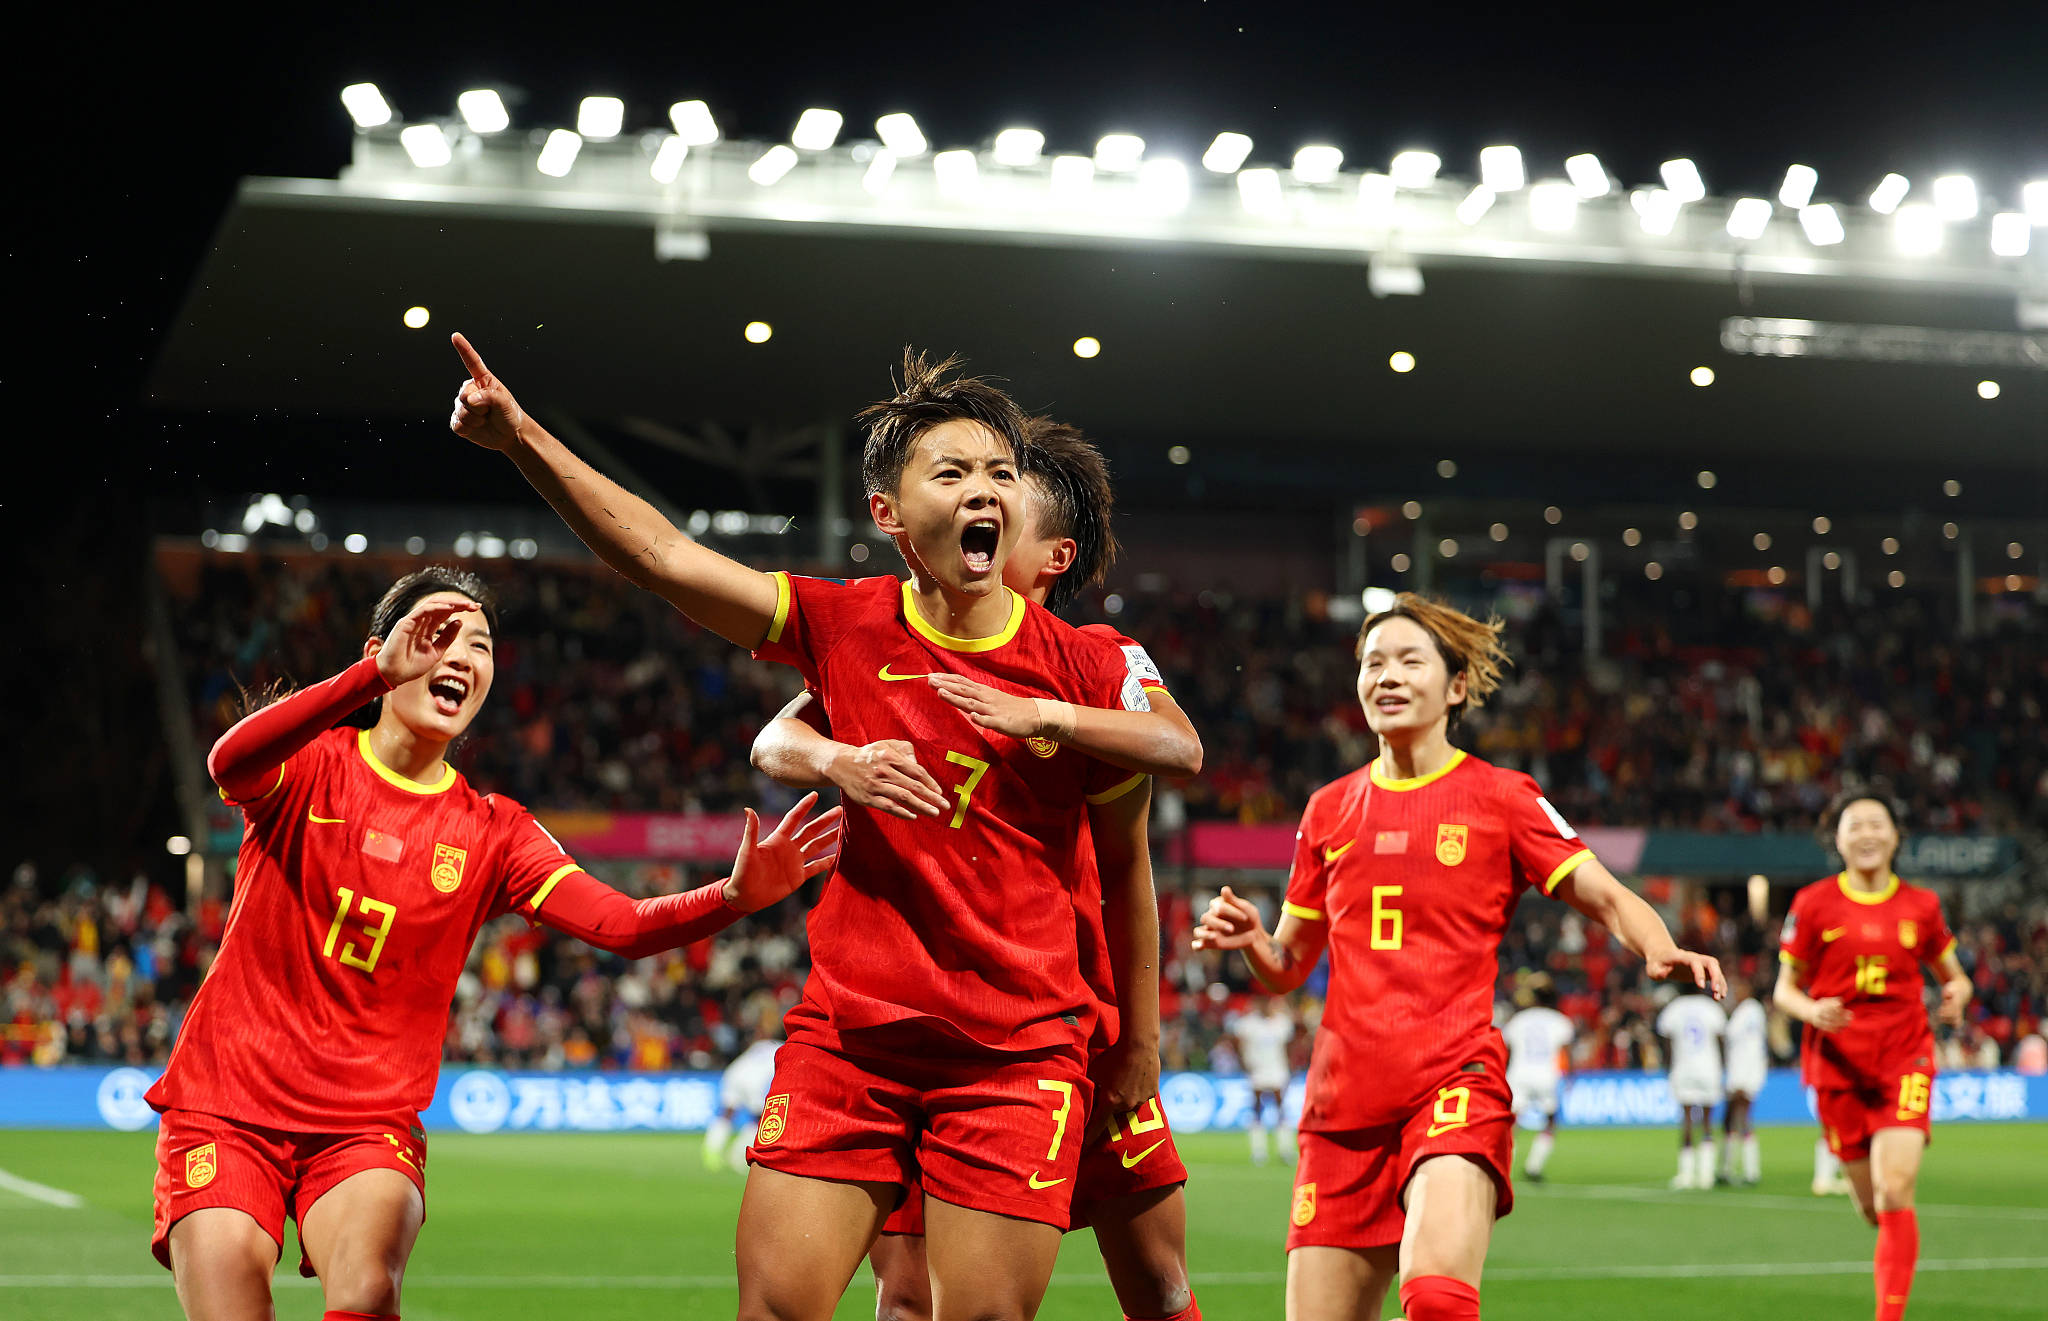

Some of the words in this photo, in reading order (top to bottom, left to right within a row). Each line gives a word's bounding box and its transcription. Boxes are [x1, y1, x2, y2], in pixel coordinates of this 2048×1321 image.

[945, 750, 990, 829] 7
[437, 847, 464, 862] CFA
[323, 887, 397, 973] 13
[1371, 885, 1404, 950] 6
[1856, 955, 1888, 995] 16
[766, 1097, 787, 1109] CFA
[1899, 1072, 1930, 1114] 16
[1038, 1079, 1073, 1161] 7
[189, 1146, 213, 1163] CFA
